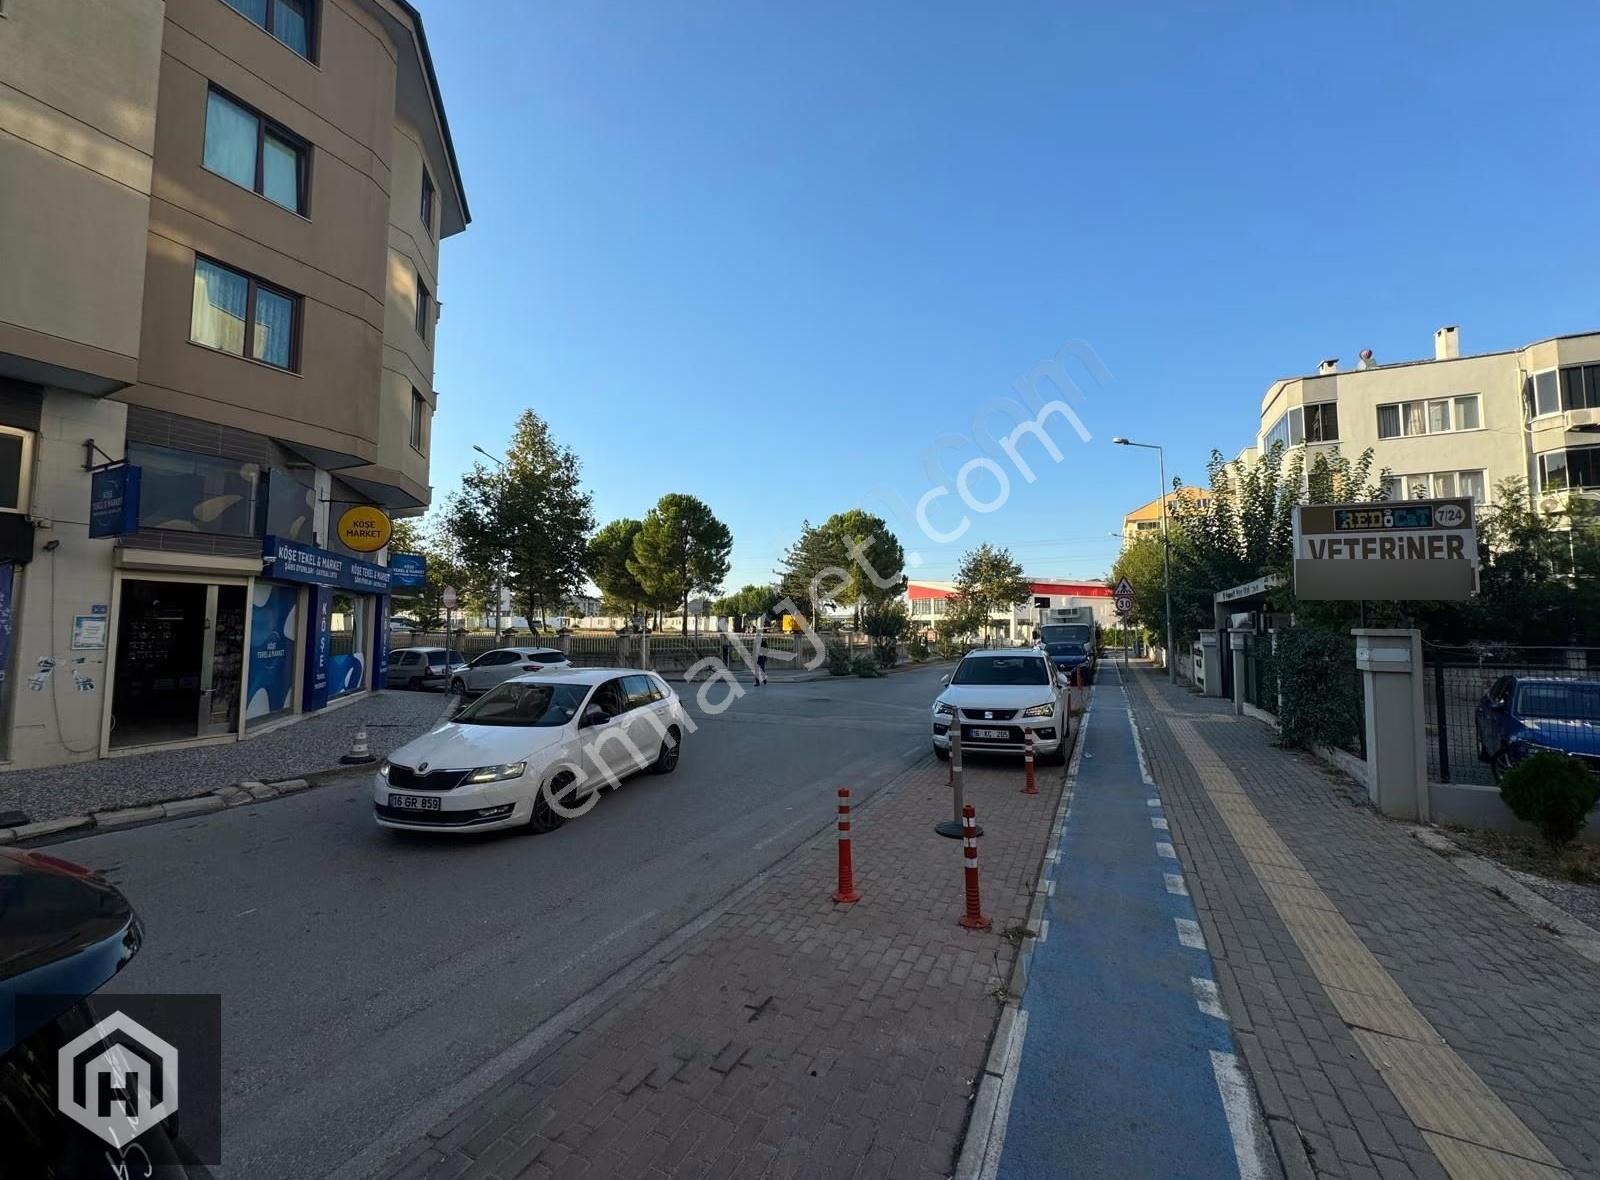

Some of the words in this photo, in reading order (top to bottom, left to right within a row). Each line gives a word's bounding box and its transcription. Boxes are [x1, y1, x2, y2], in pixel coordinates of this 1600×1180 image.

[1437, 510, 1463, 522] 7/24
[346, 529, 383, 538] MARKET
[279, 545, 297, 564] KÖŞE
[298, 551, 316, 566] TEKEL
[317, 556, 321, 567] &
[322, 557, 342, 571] MARKET
[1120, 600, 1131, 609] 30
[393, 796, 402, 806] 16
[404, 797, 418, 808] GR
[421, 798, 438, 809] 859
